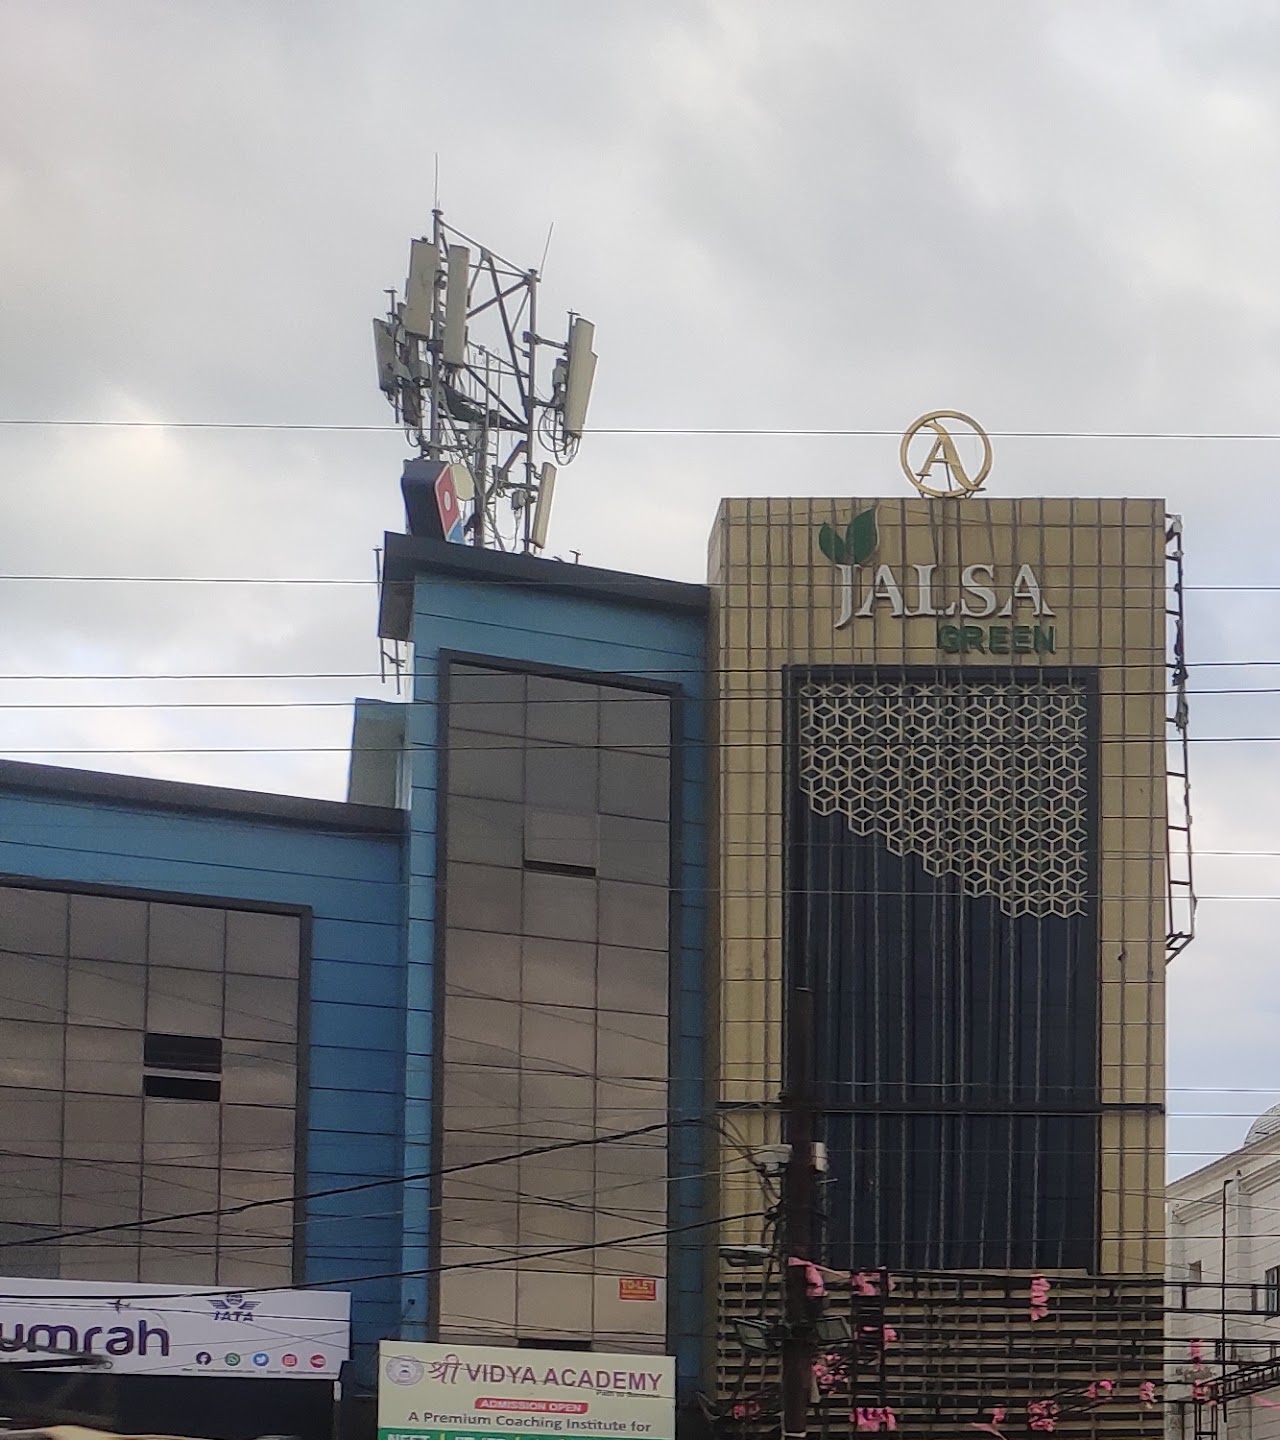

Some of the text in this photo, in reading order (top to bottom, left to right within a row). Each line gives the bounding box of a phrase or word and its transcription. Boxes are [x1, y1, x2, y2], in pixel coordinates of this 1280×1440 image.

[834, 562, 1056, 629] JALSA
[937, 624, 1056, 655] GREEN
[214, 1310, 254, 1322] IATA
[0, 1319, 170, 1357] umrah
[428, 1353, 663, 1391] श्री VIDYA ACADEMY
[480, 1398, 582, 1412] ADMISSION OPEN
[408, 1411, 652, 1432] A Premium Coaching Institute for
